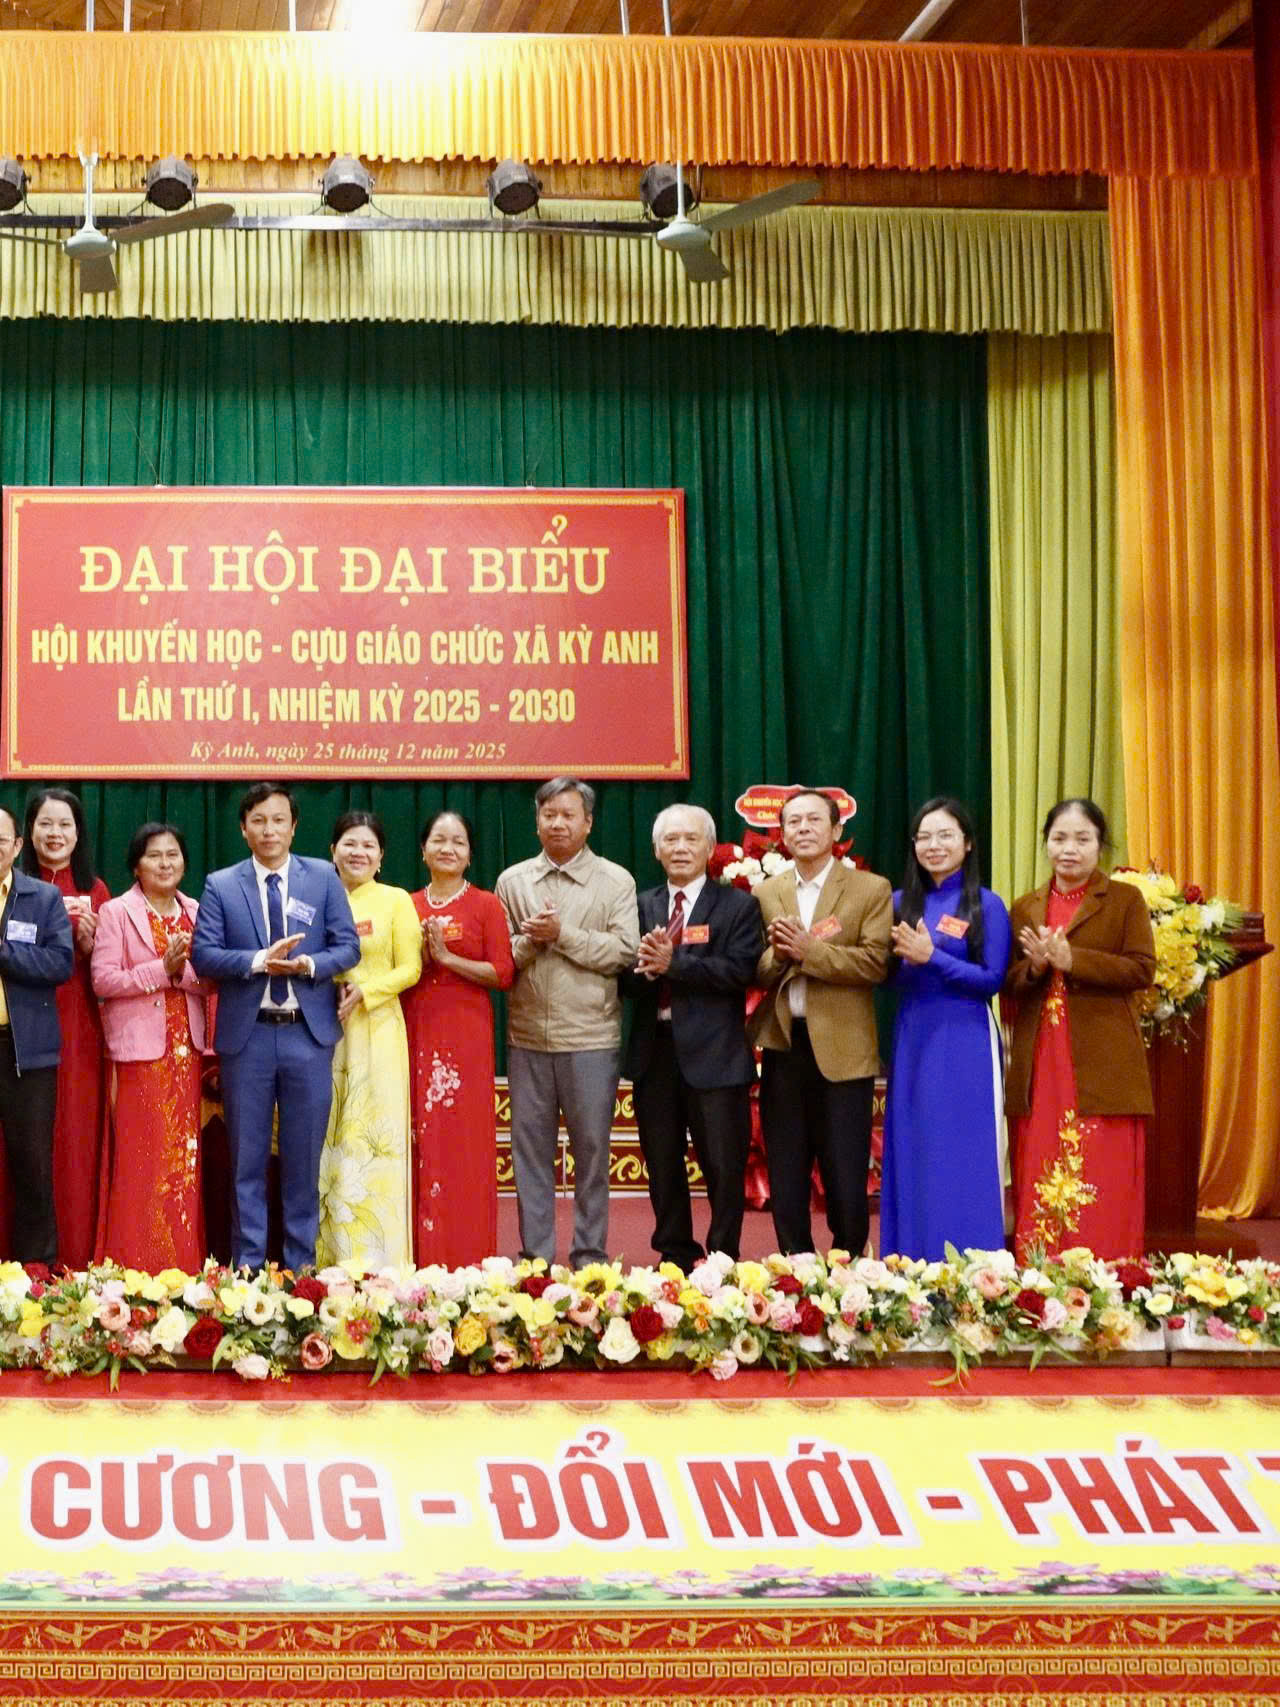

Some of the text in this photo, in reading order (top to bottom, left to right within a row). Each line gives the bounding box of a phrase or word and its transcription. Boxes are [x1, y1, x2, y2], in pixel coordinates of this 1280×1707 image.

[78, 514, 610, 607] ĐẠI HỘI ĐẠI BIỂU
[31, 618, 659, 671] HỘI KHUYẾN HỌC - CỰU GIÁO CHỨC XÃ KỲ ANH
[117, 675, 576, 730] LẦN THỨ I, NHIỆM KỲ 2025 - 2030
[190, 741, 507, 764] Kỳ Anh, ngày 25 tháng 12 năm 2025
[29, 1452, 388, 1541] CƯƠNG
[422, 1499, 457, 1514] -
[485, 1430, 670, 1541] ĐỔI
[686, 1442, 904, 1539] MỚI
[927, 1495, 965, 1511] -
[978, 1439, 1262, 1536] PHÁT
